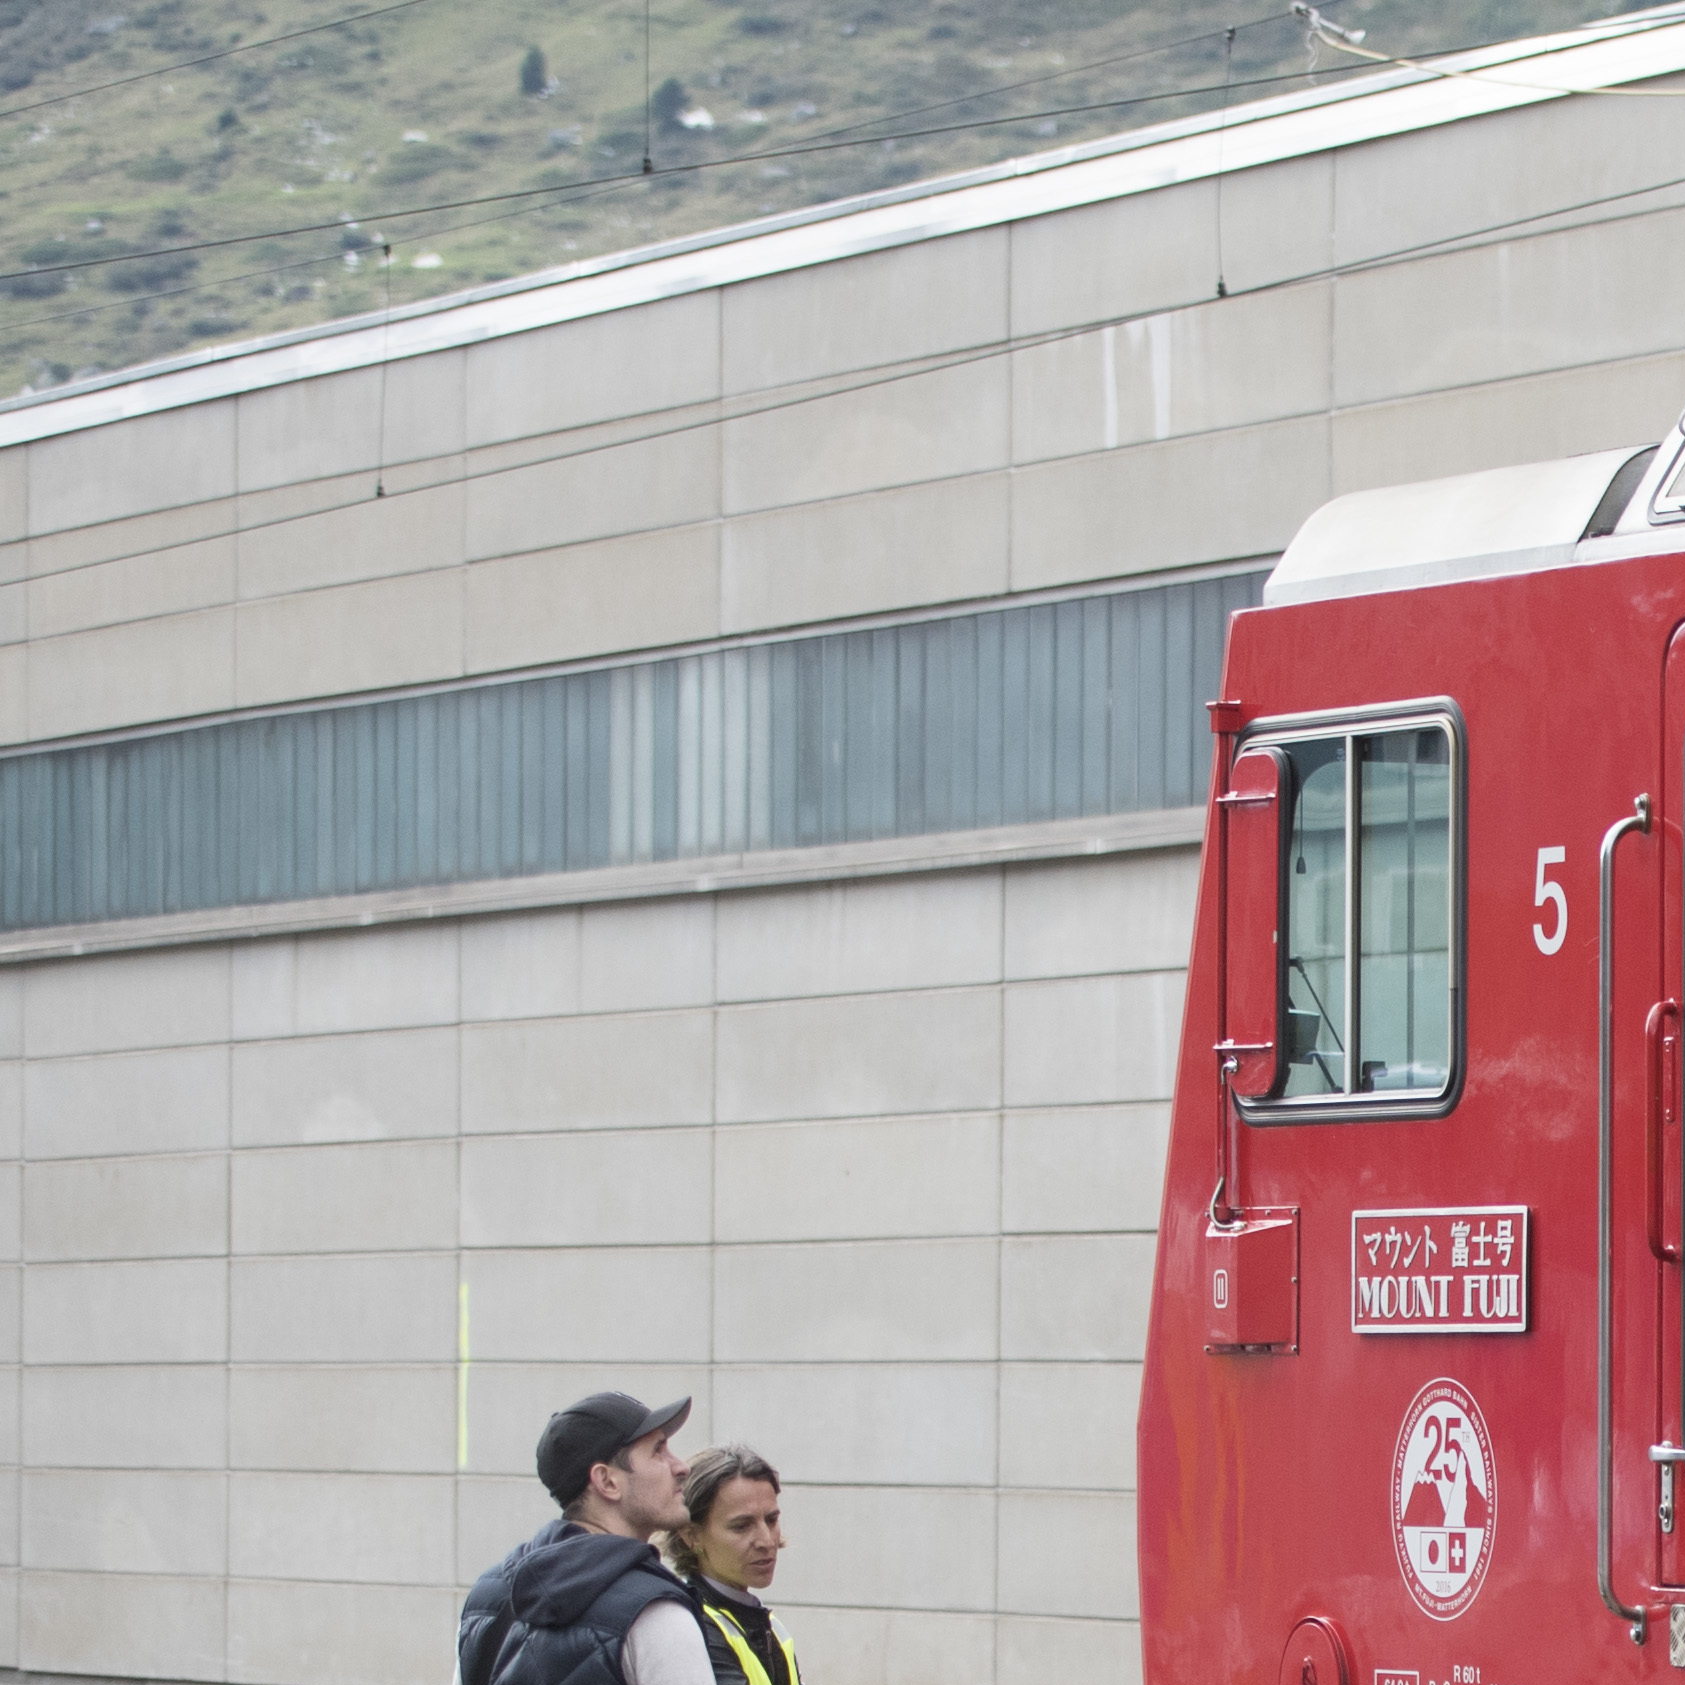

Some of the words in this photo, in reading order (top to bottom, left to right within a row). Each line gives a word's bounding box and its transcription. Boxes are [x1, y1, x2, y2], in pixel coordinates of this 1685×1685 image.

[1533, 845, 1568, 956] 5
[1362, 1225, 1438, 1269] マウント
[1451, 1219, 1515, 1268] 富士号
[1358, 1275, 1454, 1319] MOUNT
[1462, 1274, 1520, 1319] FUJI
[1397, 1403, 1422, 1469] MATTERHORN
[1422, 1388, 1452, 1406] GOTTHARD
[1453, 1390, 1468, 1410] BAHN
[1470, 1411, 1486, 1448] SISTER
[1483, 1451, 1494, 1513] RAILWAYS
[1482, 1518, 1493, 1555] SINCE
[1435, 1580, 1452, 1593] 2016
[1453, 1664, 1461, 1683] R
[1462, 1666, 1475, 1684] 60
[1476, 1667, 1481, 1684] t
